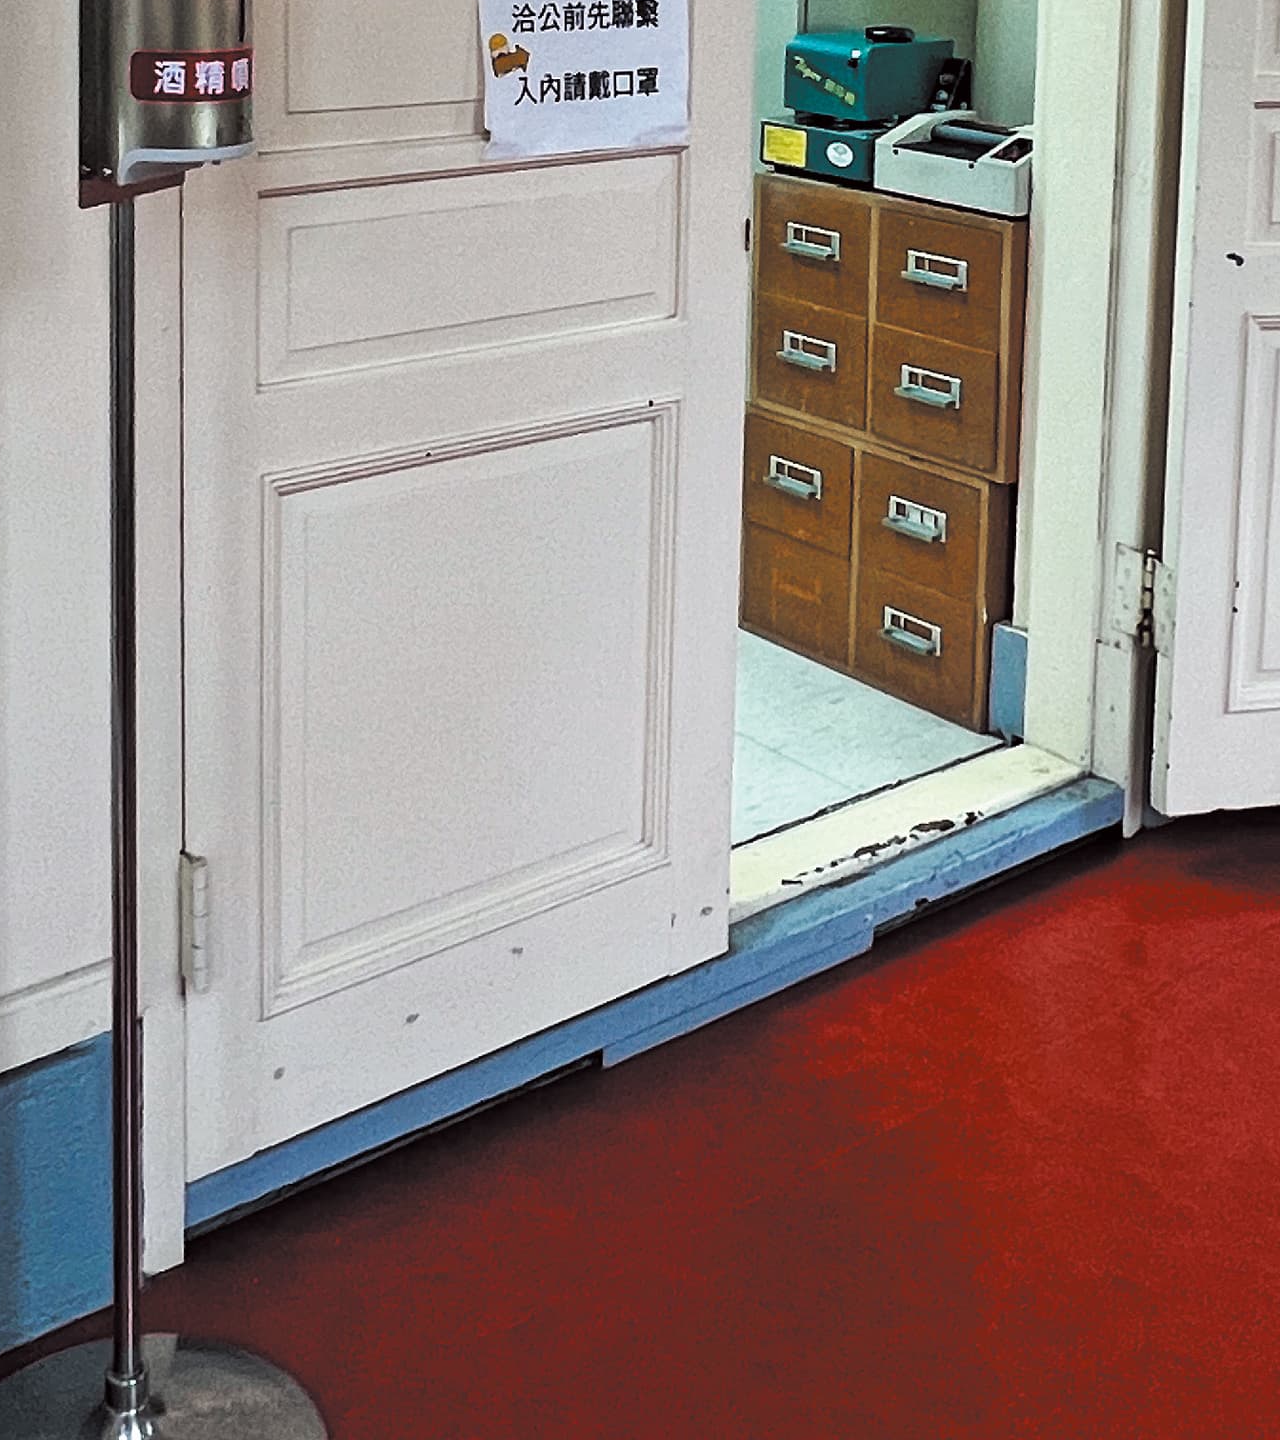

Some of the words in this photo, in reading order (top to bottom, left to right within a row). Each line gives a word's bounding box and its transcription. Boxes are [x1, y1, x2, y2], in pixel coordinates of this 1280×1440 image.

[514, 67, 659, 106] 入內請戴口罩
